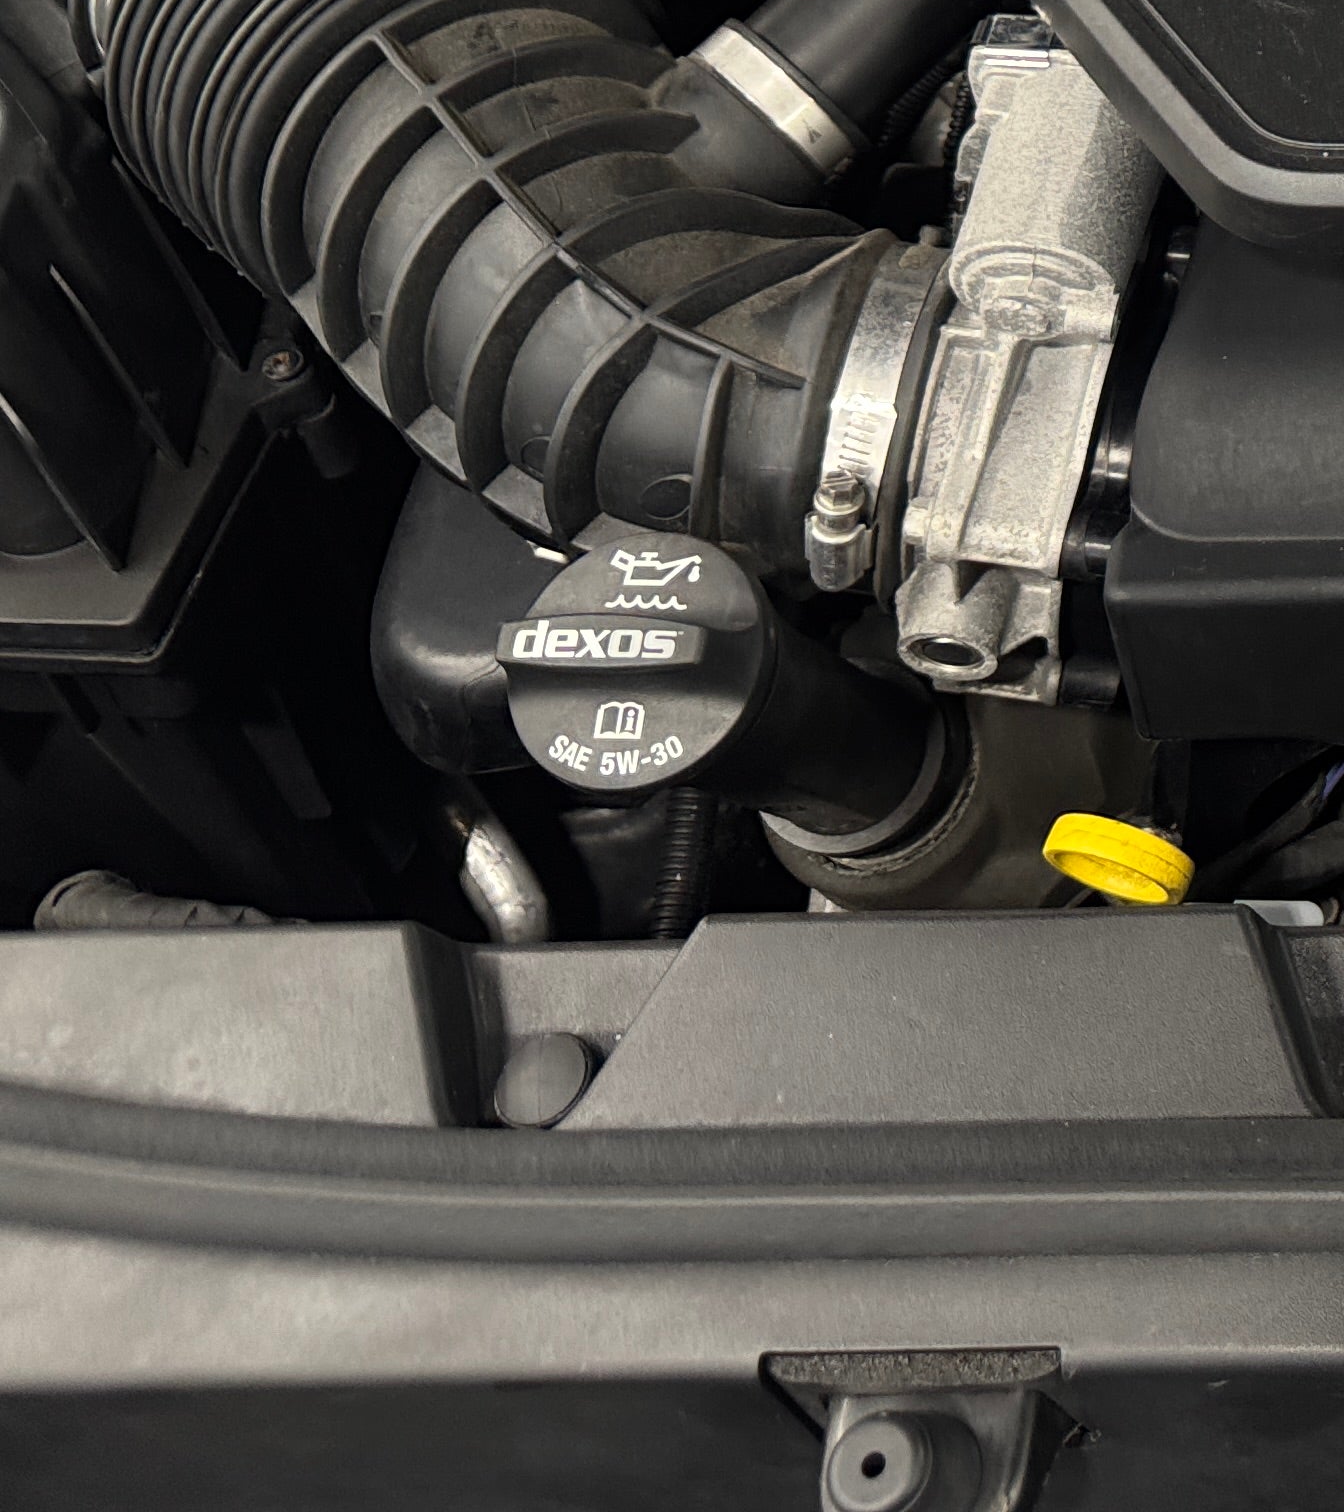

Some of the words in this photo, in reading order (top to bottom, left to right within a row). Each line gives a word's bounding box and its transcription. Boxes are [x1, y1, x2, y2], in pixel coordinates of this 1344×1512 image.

[512, 620, 677, 659] dexos
[549, 735, 592, 772] SAE
[600, 735, 684, 776] 5W-30
